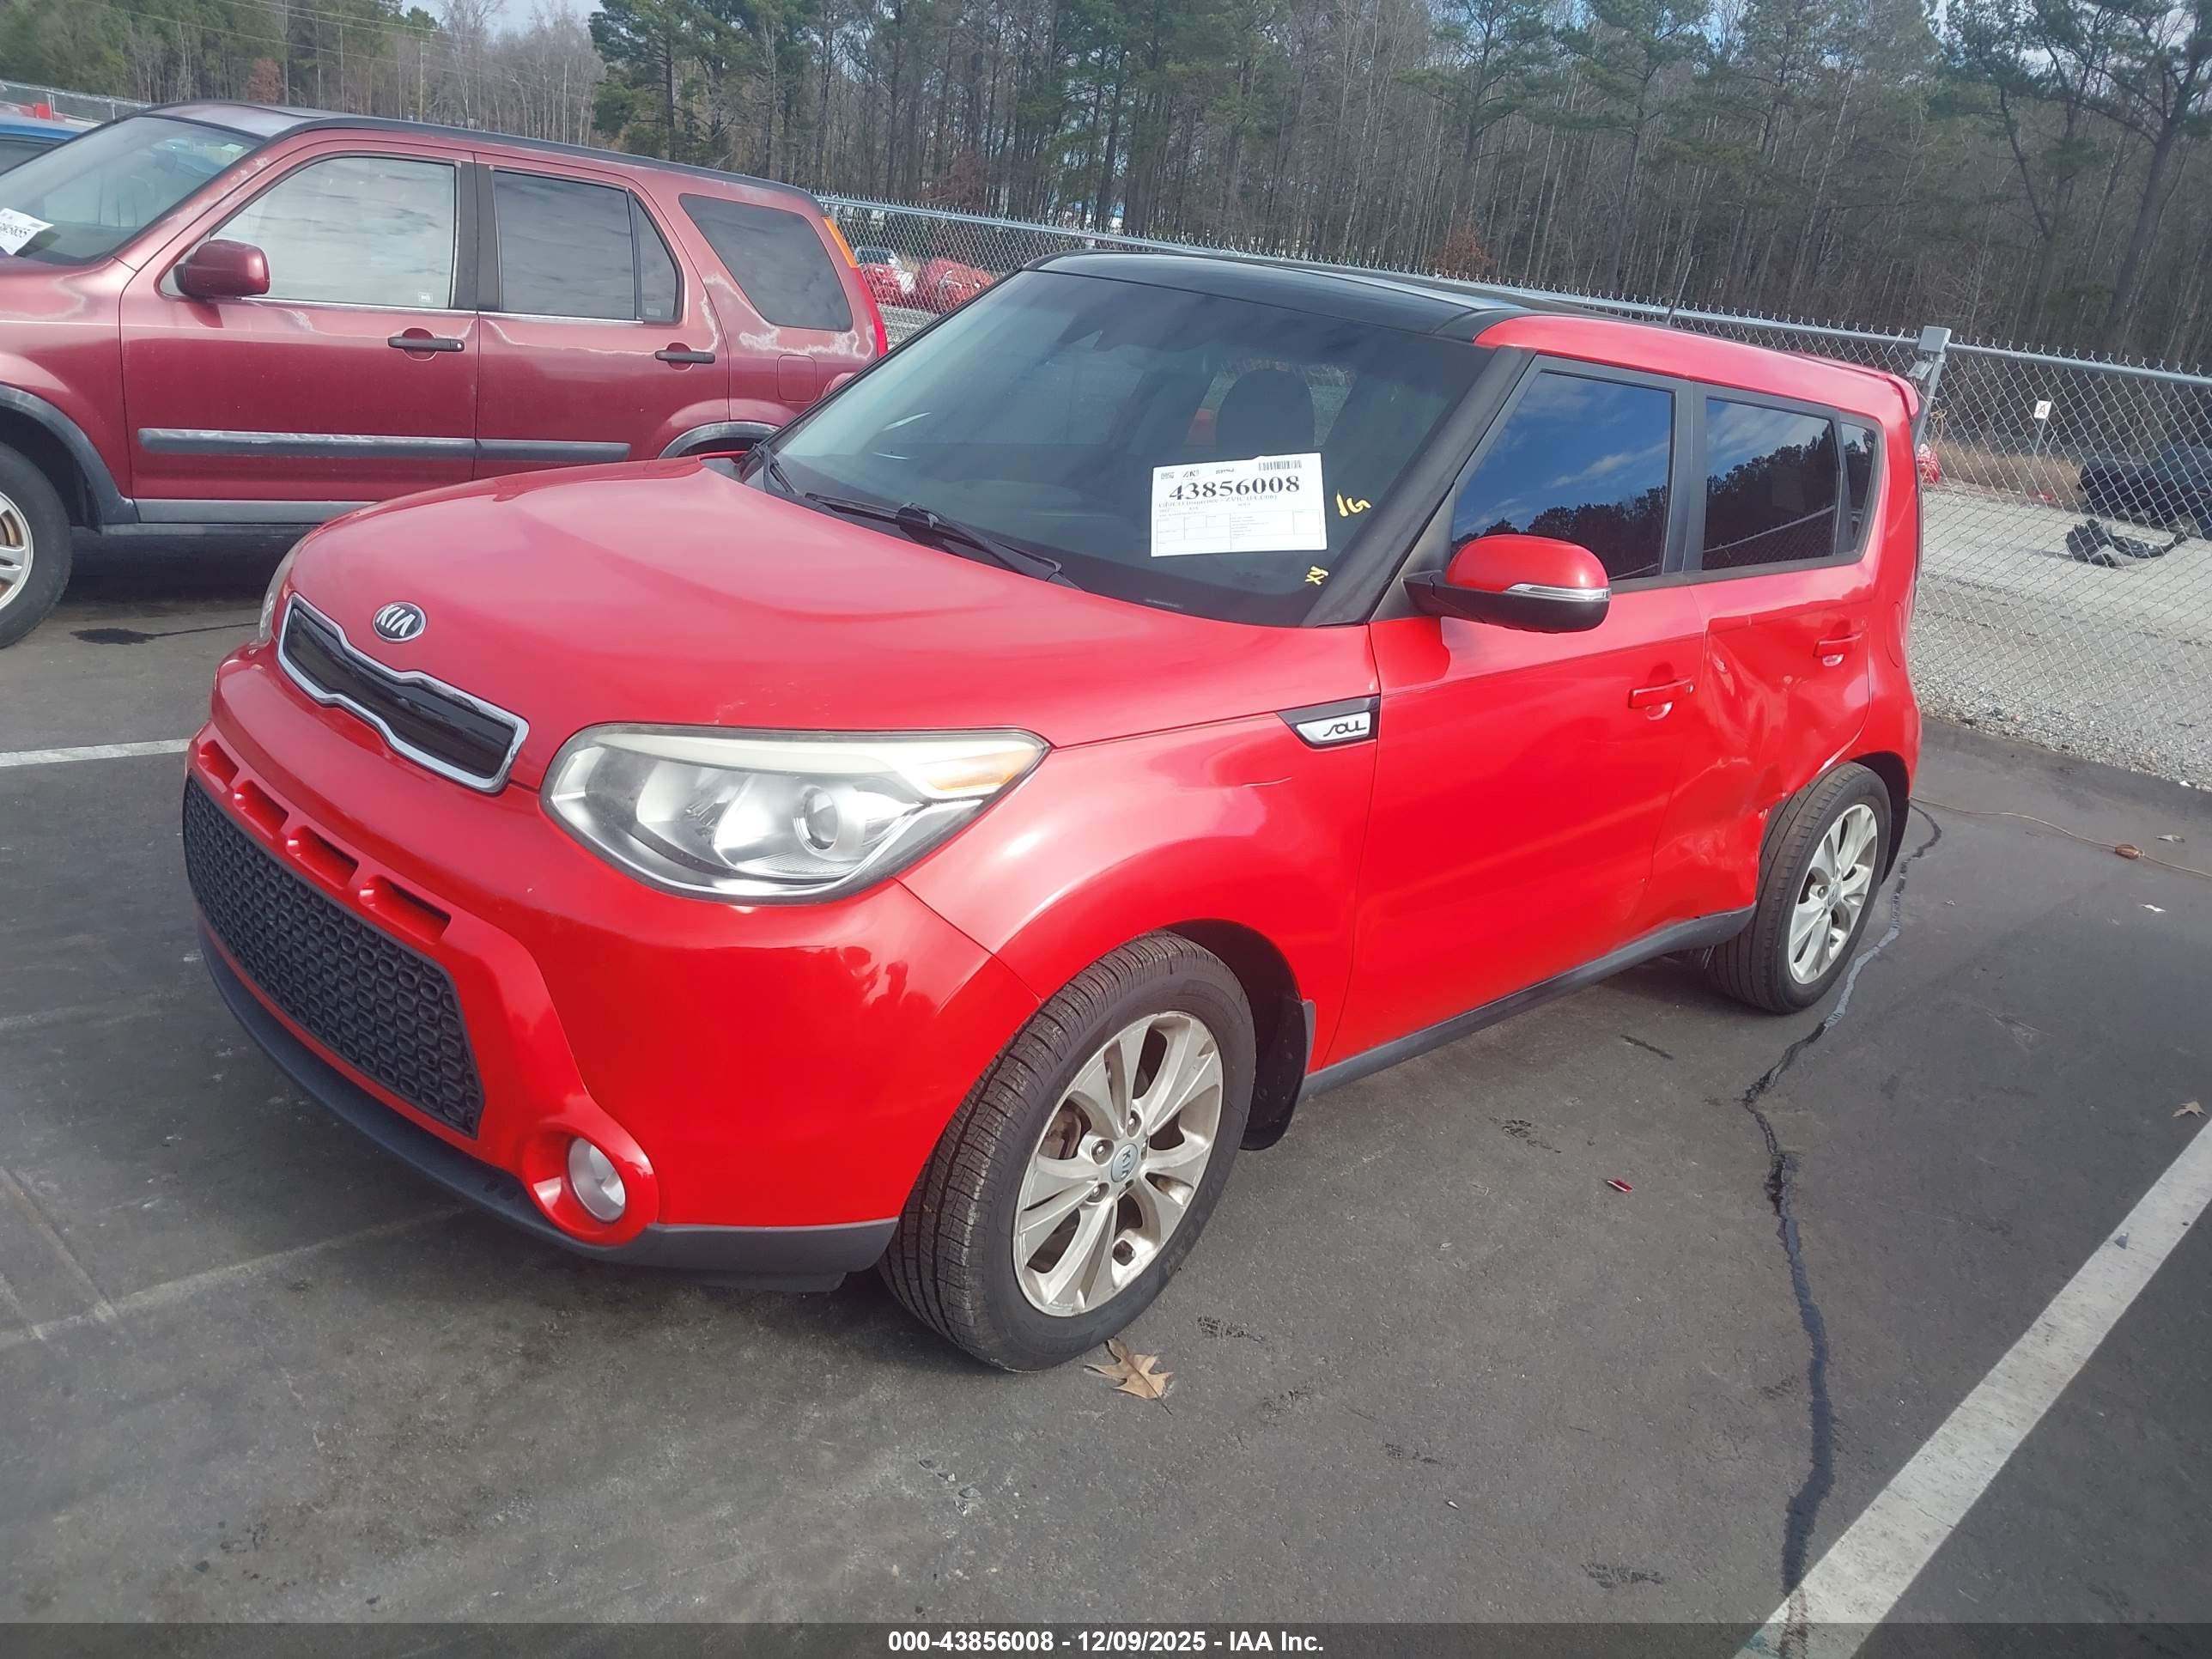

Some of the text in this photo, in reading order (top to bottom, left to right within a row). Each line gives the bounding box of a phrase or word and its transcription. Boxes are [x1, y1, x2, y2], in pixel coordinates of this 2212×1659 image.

[1169, 475, 1300, 501] 43856008
[376, 605, 416, 636] KIA
[1323, 720, 1367, 737] SOUL
